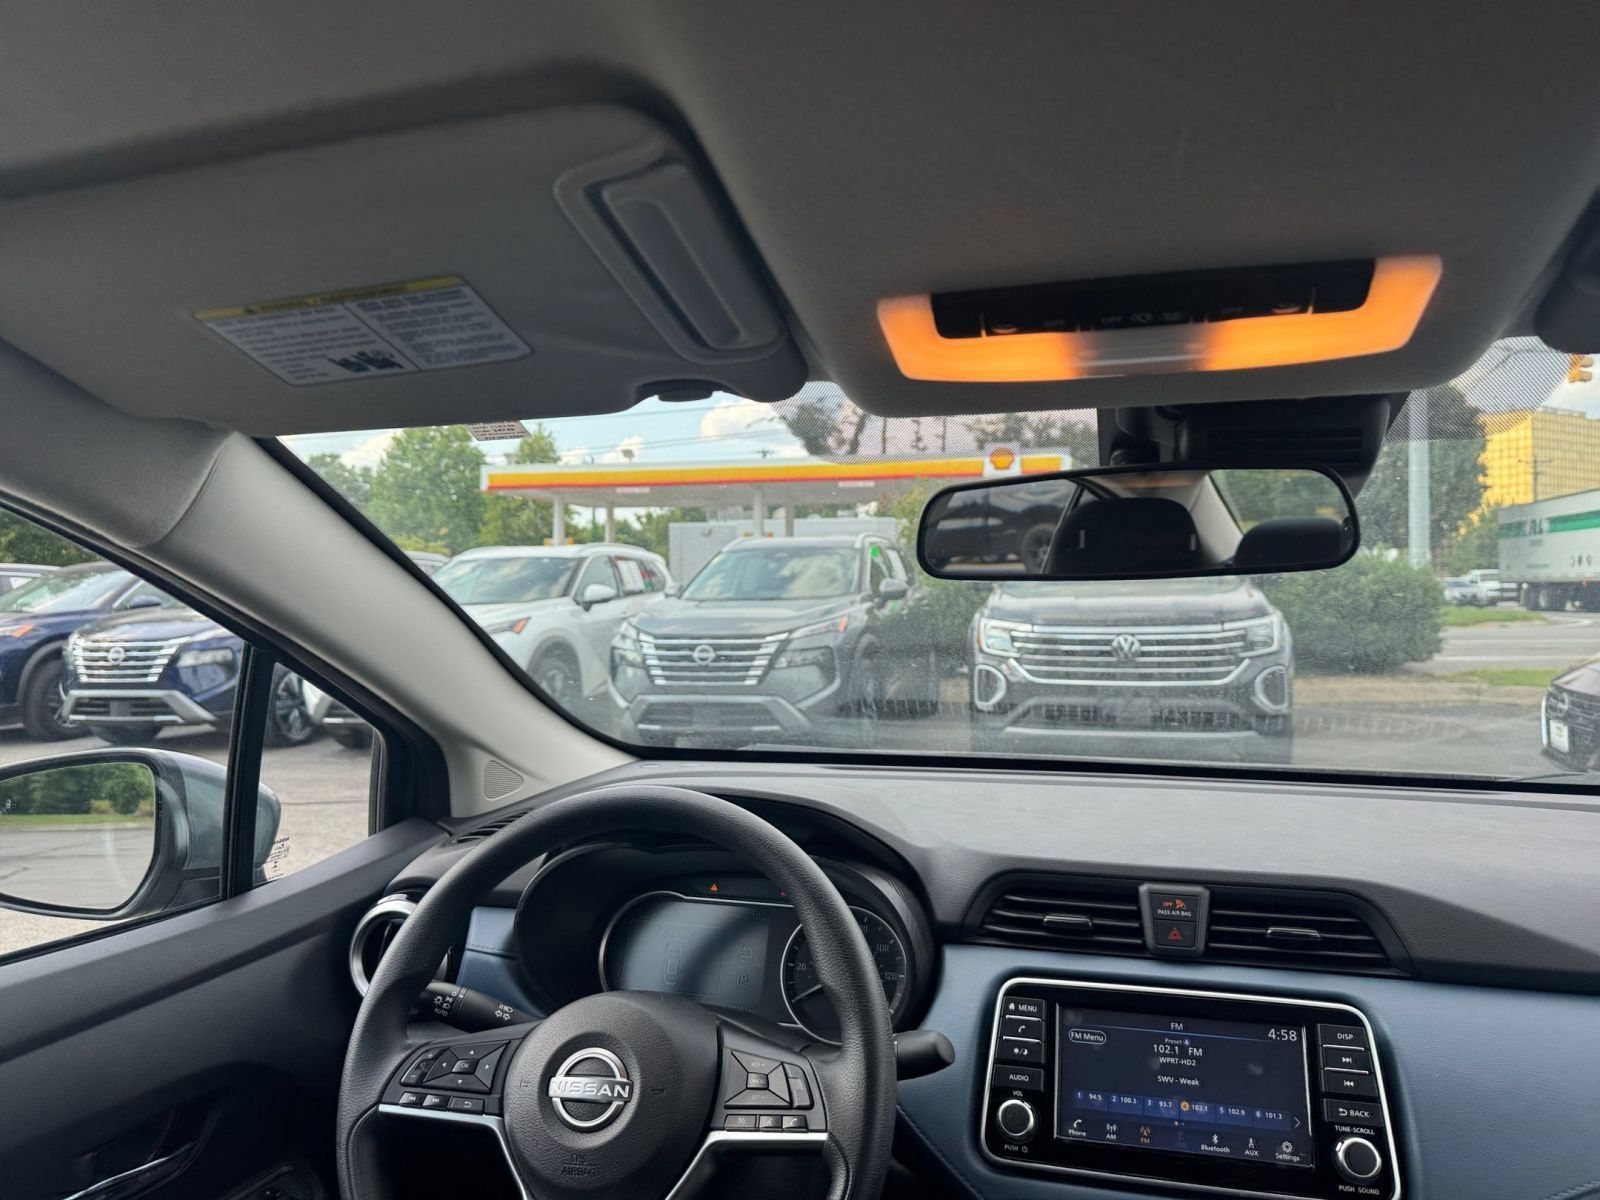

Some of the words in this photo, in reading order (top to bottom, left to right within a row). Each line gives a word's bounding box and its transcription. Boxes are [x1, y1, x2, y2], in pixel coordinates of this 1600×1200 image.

[433, 1007, 448, 1017] AUTO
[1018, 1004, 1037, 1012] MENU
[1170, 1022, 1184, 1031] FM
[1070, 1031, 1082, 1040] FM
[1083, 1032, 1104, 1042] Menu
[1268, 1028, 1298, 1042] 4:58
[1337, 1032, 1354, 1041] DISP
[1164, 1037, 1183, 1045] Preset
[1152, 1044, 1180, 1055] 102.1
[1188, 1047, 1203, 1057] FM
[1159, 1056, 1197, 1067] WPRT-HD2
[1009, 1073, 1029, 1082] AUDIO
[1157, 1075, 1175, 1084] SWV
[1180, 1077, 1200, 1086] Weak
[550, 1080, 630, 1098] NISSAN
[1120, 1096, 1137, 1104] 100.3
[1159, 1100, 1173, 1108] 93.7
[1191, 1104, 1208, 1112] 102.1
[1228, 1108, 1246, 1116] 102.9
[1265, 1112, 1283, 1120] 101.3
[1349, 1109, 1370, 1118] BACK
[1068, 1128, 1087, 1137] Phone
[1004, 1144, 1019, 1152] PUSH
[1200, 1143, 1230, 1153] Bluetooth
[1275, 1153, 1301, 1162] Settings
[1338, 1184, 1355, 1193] PUSH
[1358, 1186, 1380, 1195] SOUND
